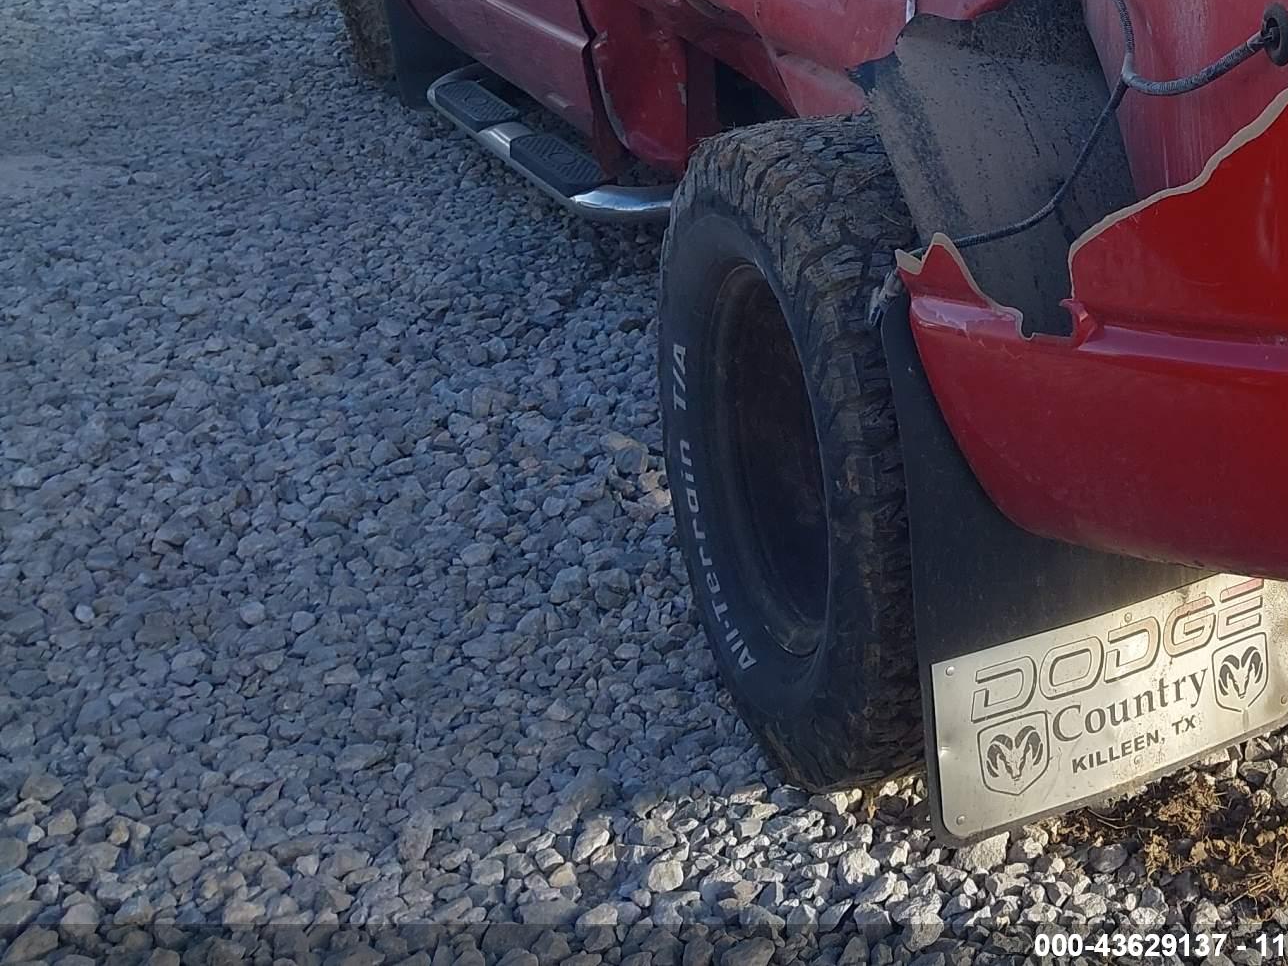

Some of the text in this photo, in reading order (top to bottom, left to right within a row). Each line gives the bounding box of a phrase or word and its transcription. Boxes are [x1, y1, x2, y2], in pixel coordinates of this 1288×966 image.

[673, 344, 757, 671] All-Terrain T/A
[970, 577, 1265, 723] DODGE
[1053, 668, 1207, 742] Country
